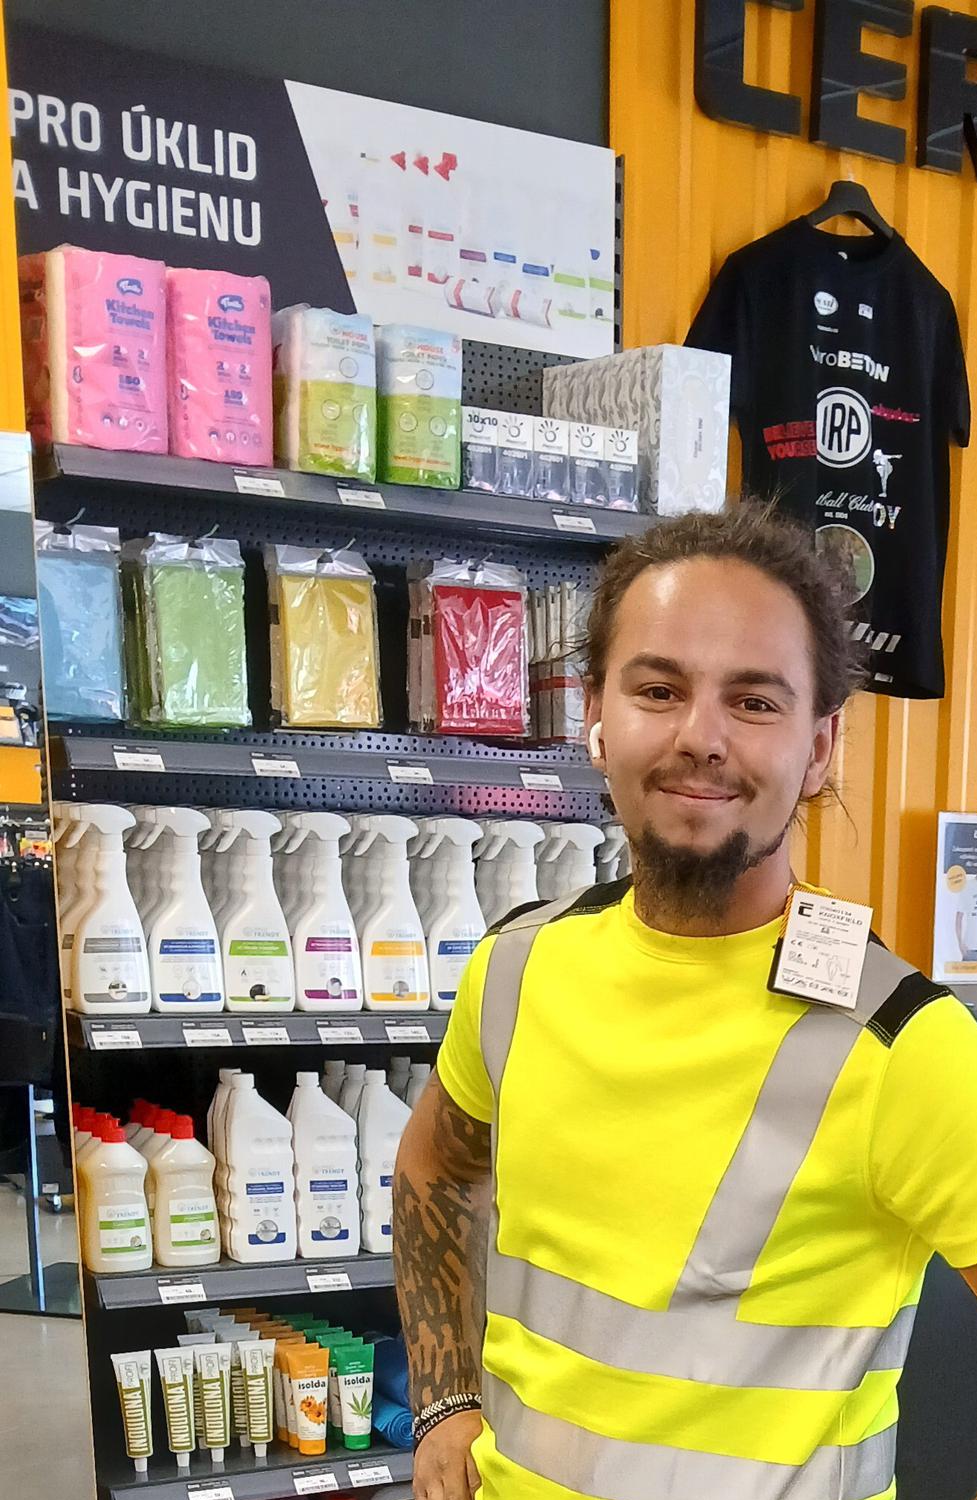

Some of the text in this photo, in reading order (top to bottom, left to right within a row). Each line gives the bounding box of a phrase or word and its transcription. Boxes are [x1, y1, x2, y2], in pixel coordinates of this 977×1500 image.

[9, 87, 257, 182] PRO ÚKLID
[58, 166, 262, 247] HYGIENU
[106, 299, 154, 320] Kitchen
[110, 312, 151, 331] Towels
[207, 316, 256, 335] Kitchen
[213, 330, 252, 345] Towels
[298, 1379, 326, 1390] isolda
[344, 1375, 371, 1386] isolda
